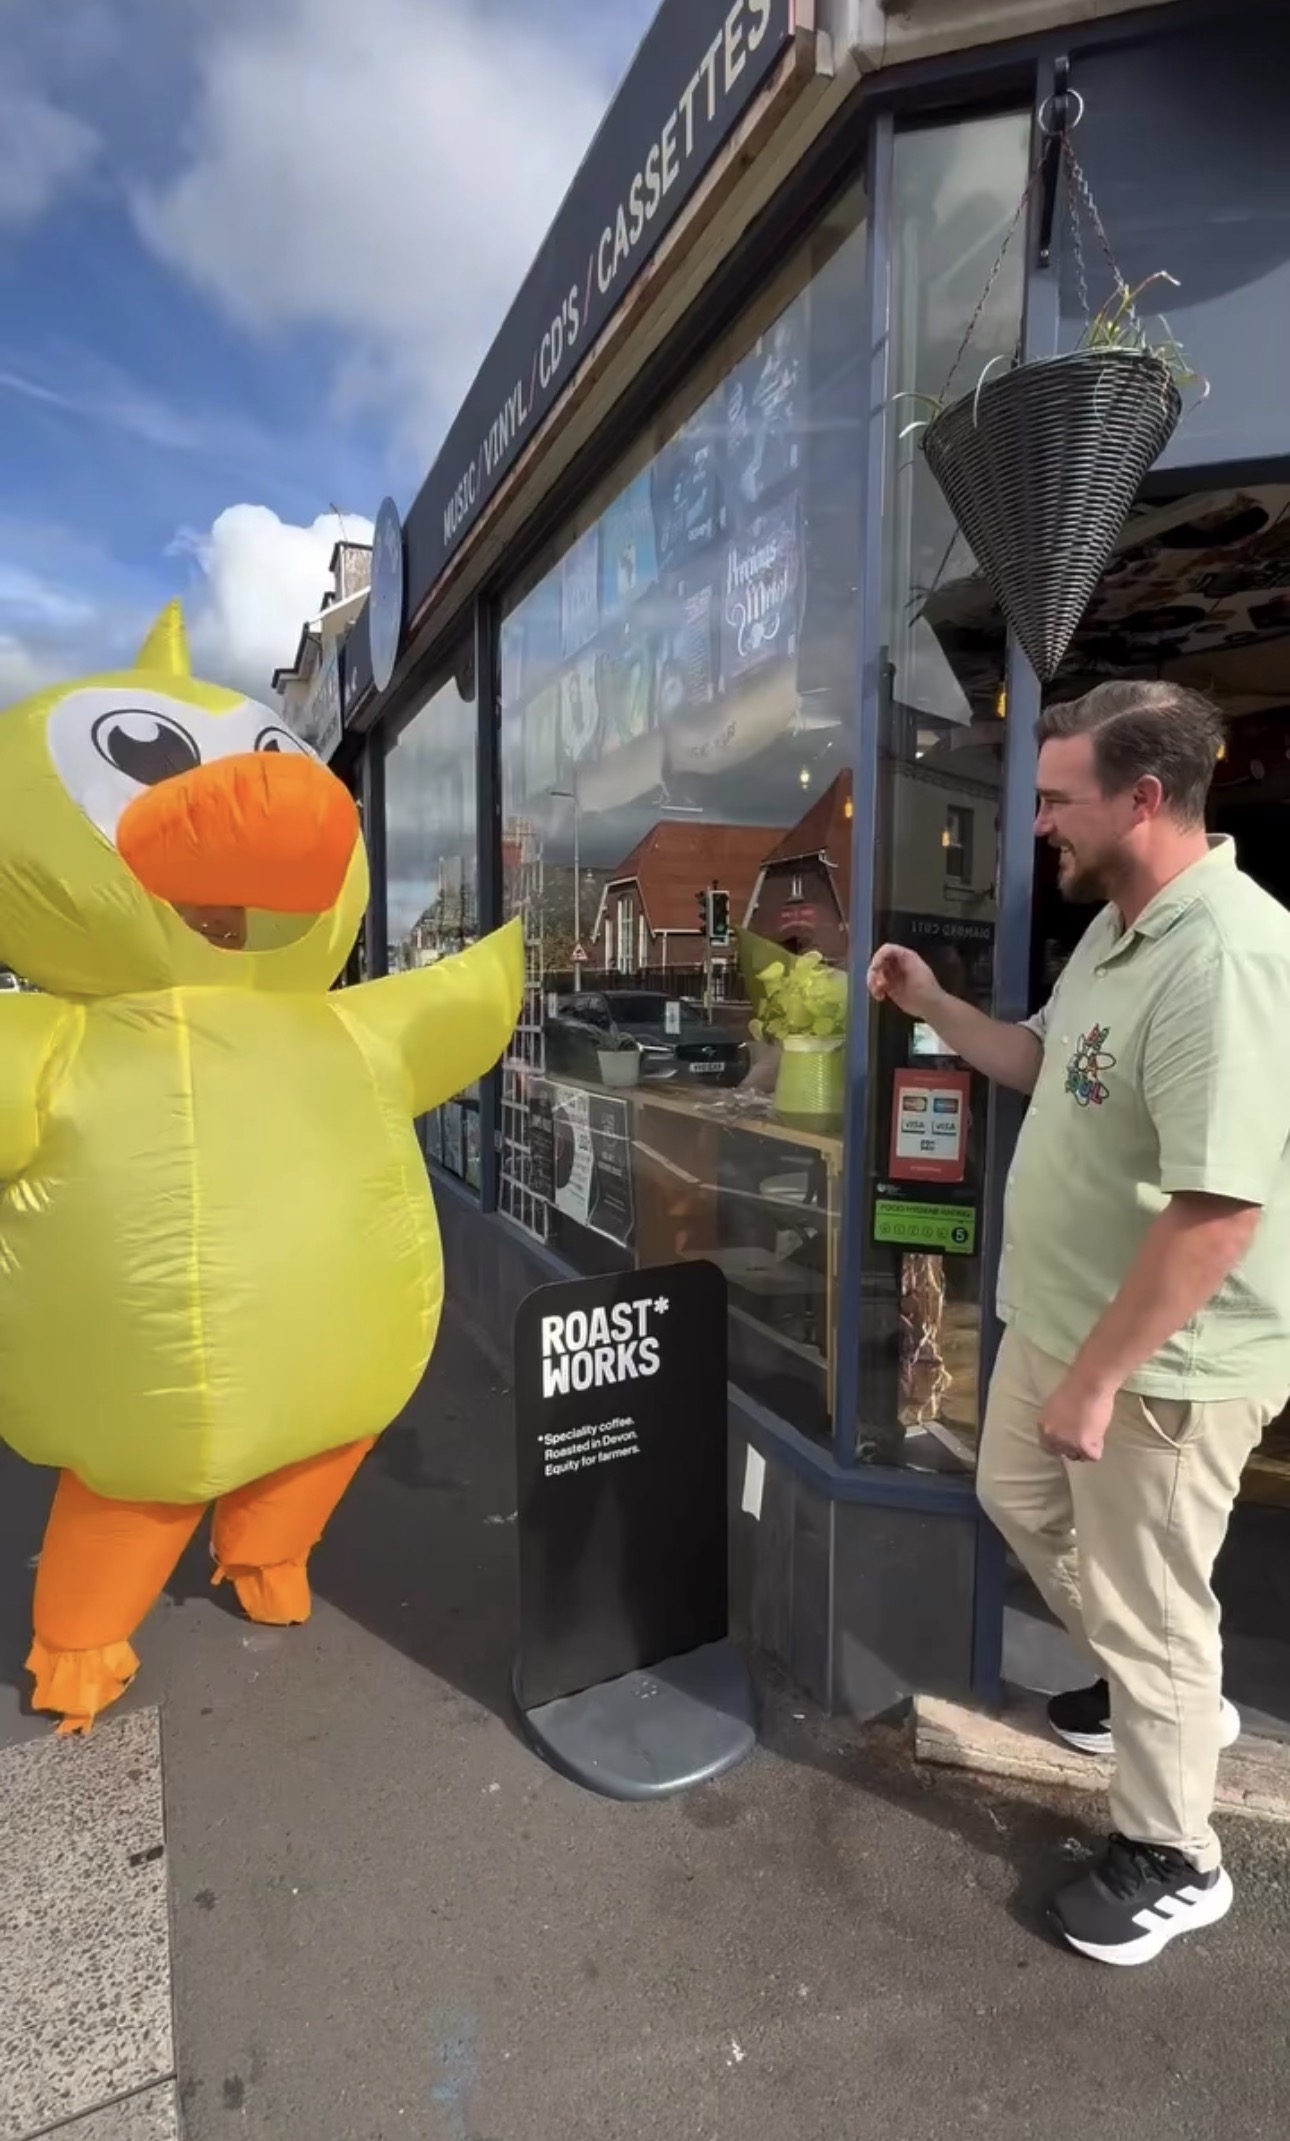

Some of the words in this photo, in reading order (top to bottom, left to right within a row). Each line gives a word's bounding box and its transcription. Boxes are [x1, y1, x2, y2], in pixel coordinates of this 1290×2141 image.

[443, 461, 476, 547] MUSIC
[483, 377, 528, 477] VINYL
[539, 283, 580, 389] CD'S
[955, 1228, 966, 1241] 5
[542, 1336, 661, 1399] WORKS
[544, 1439, 590, 1461] Roasted
[590, 1438, 601, 1449] in
[544, 1459, 580, 1478] Equity
[581, 1455, 597, 1467] for
